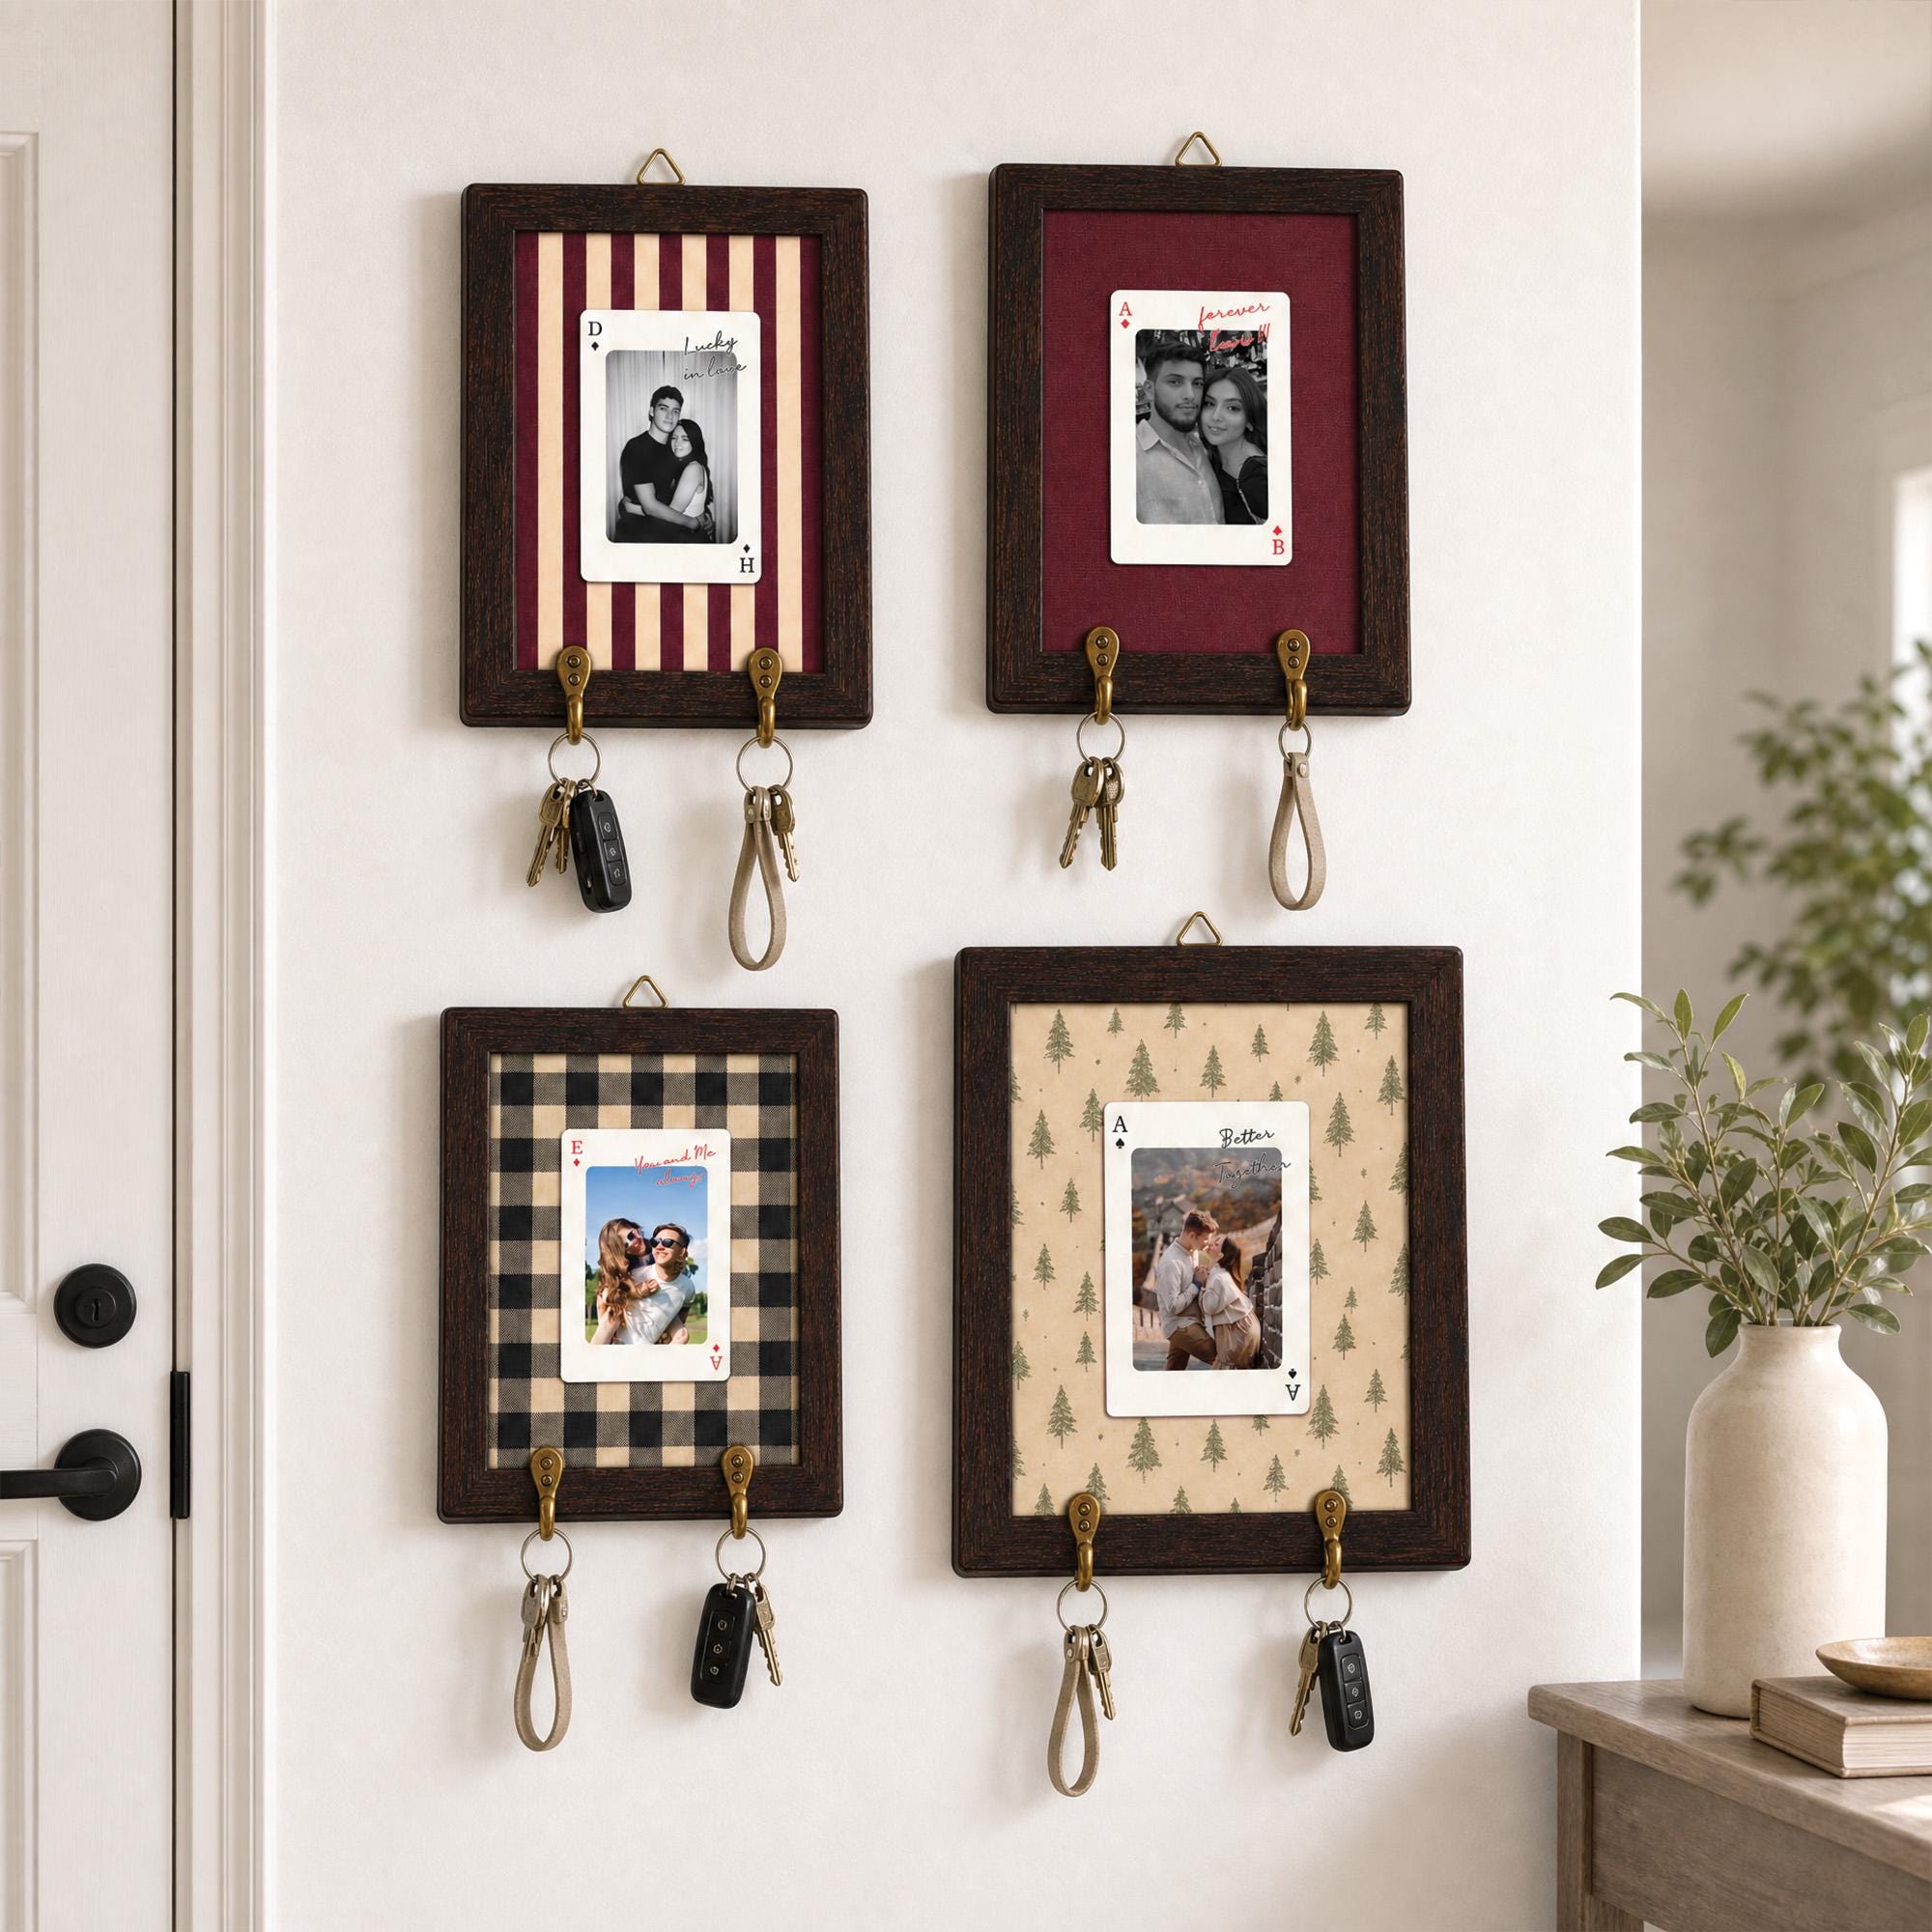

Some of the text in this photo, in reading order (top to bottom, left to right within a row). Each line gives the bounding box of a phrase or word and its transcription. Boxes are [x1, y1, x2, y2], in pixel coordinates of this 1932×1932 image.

[1119, 301, 1132, 316] A
[1198, 302, 1270, 333] forever
[587, 321, 603, 336] D
[684, 330, 738, 356] Lucky
[684, 355, 747, 381] in love
[1272, 539, 1285, 555] B
[739, 556, 755, 573] H
[1112, 1115, 1128, 1133] A
[571, 1140, 583, 1155] E
[1219, 1127, 1275, 1150] Better
[635, 1143, 717, 1176] You and Me
[1213, 1152, 1292, 1190] Together
[710, 1355, 724, 1371] A
[1285, 1383, 1301, 1401] A
